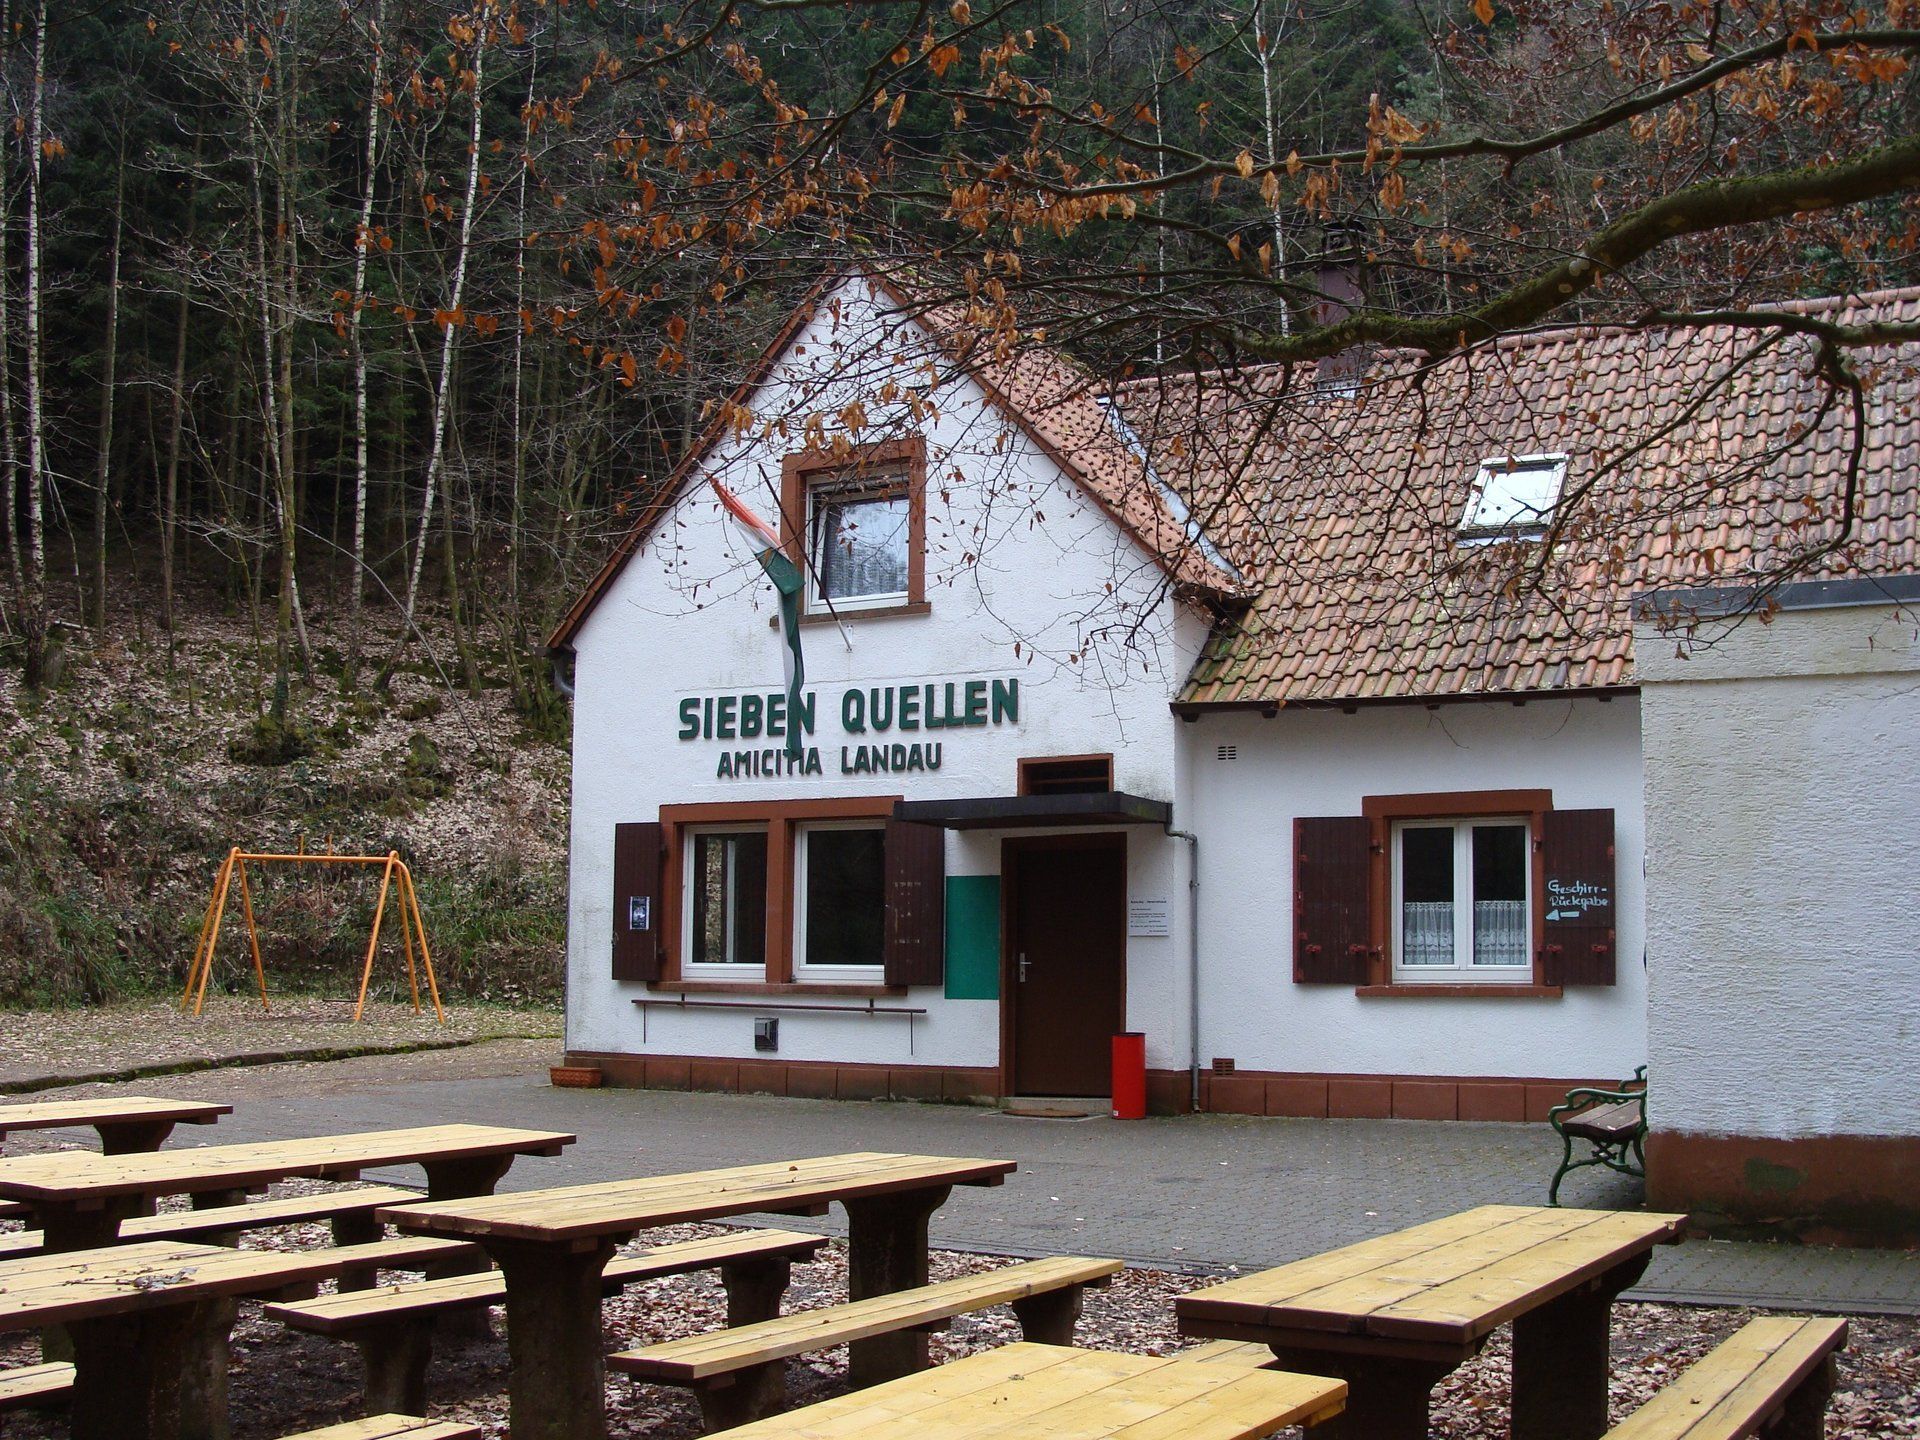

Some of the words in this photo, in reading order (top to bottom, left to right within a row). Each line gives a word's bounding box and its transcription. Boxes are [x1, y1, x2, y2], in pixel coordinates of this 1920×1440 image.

[678, 692, 816, 739] SIEBEN
[841, 678, 1019, 733] QUELLEN
[841, 742, 942, 774] LANDAU
[1548, 879, 1608, 896] Geschirr-
[1549, 896, 1609, 911] Rückgabe
